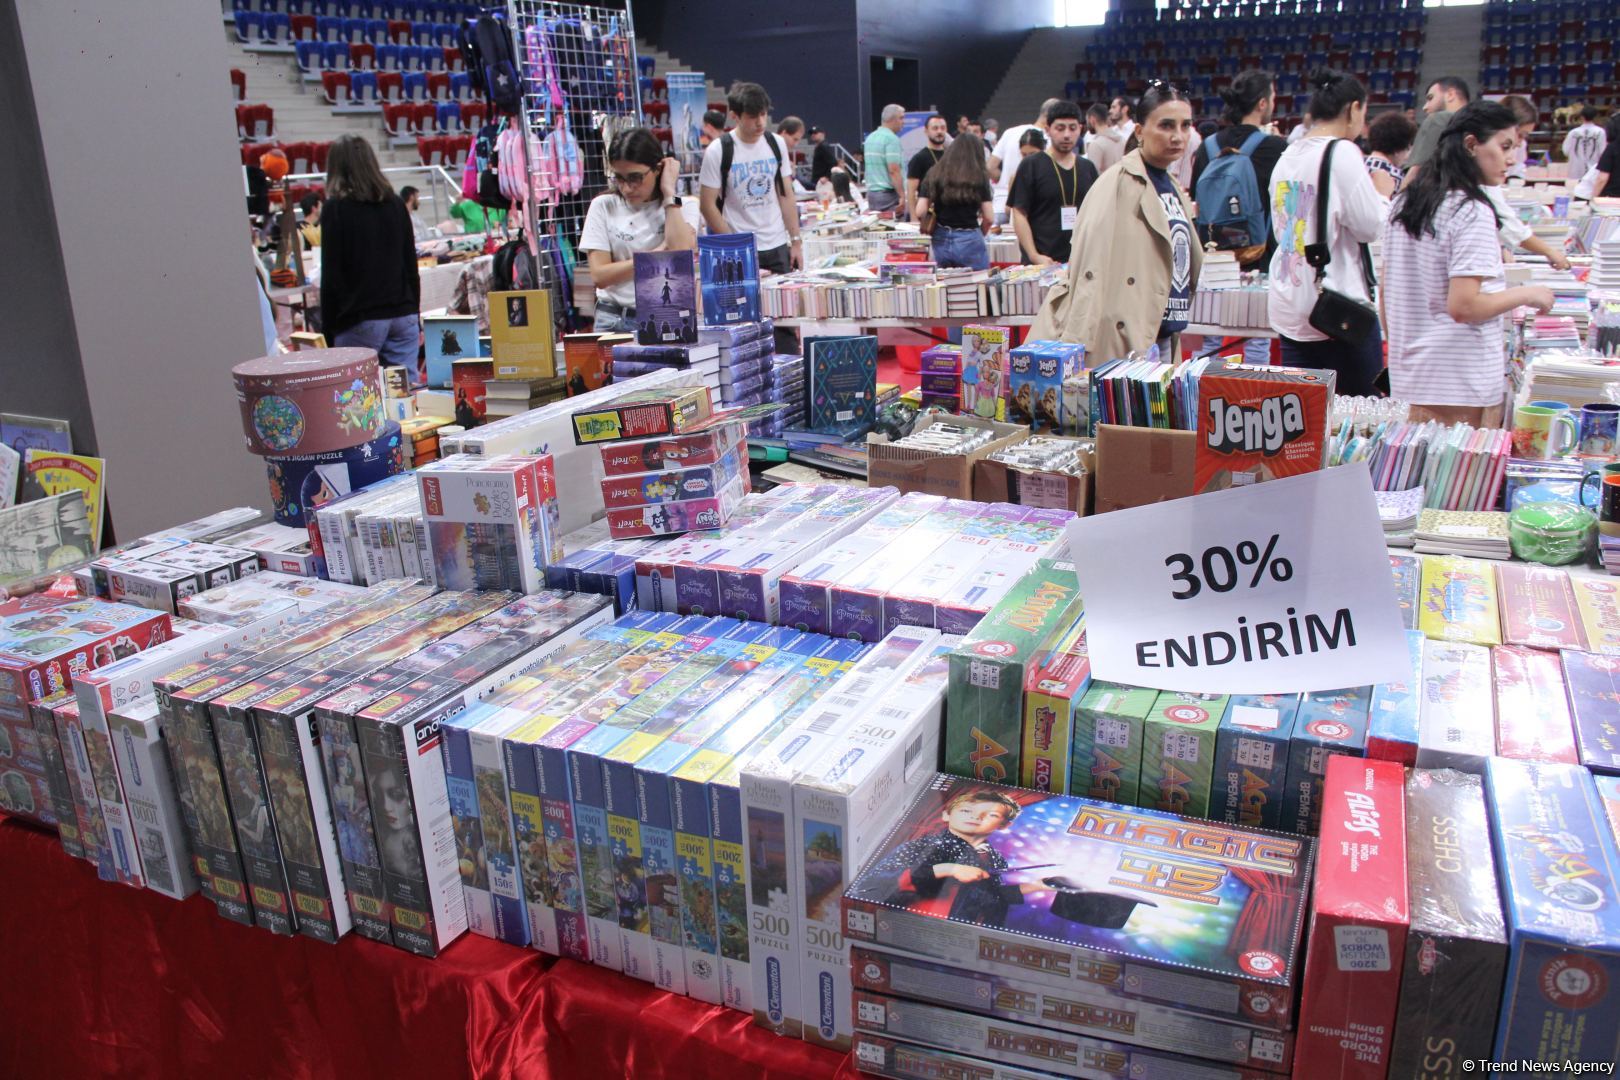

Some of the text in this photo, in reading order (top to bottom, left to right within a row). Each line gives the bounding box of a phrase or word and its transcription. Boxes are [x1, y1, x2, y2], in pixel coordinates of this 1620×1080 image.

[1013, 355, 1031, 368] Jenga
[1039, 359, 1057, 371] Jenga
[1208, 392, 1304, 451] Jenga
[1284, 441, 1315, 449] Classique
[291, 454, 316, 462] JIGSAW
[316, 451, 343, 461] PUZZLE
[612, 456, 629, 466] Trefl
[427, 480, 439, 502] Trefl
[611, 488, 629, 499] Trefl
[492, 490, 502, 518] Puzzle
[502, 491, 513, 518] 500
[617, 519, 634, 530] Trefl
[655, 515, 665, 524] 30
[1164, 533, 1294, 600] 30%
[724, 587, 758, 602] PRINCESS
[793, 596, 811, 605] Disney
[784, 600, 819, 616] PRINCESS
[847, 605, 865, 614] Disney
[836, 609, 873, 625] PRINCESS
[900, 613, 919, 622] Disney
[1135, 606, 1357, 668] ENDİRİM
[853, 723, 897, 740] 500
[506, 743, 517, 789] Ravensburger
[536, 747, 547, 794] Ravensburger
[571, 753, 583, 801] Ravensburger
[603, 763, 614, 811] Ravensburger
[1228, 772, 1238, 805] ВРЕМЯ
[636, 773, 648, 822] Ravensburger
[676, 781, 685, 829] Ravensburger
[1299, 782, 1311, 817] ВРЕМЯ
[103, 804, 122, 818] 2x60
[132, 804, 159, 826] 1000
[518, 802, 535, 814] 300
[549, 807, 565, 819] 100
[711, 786, 721, 837] Ravensburger
[615, 825, 633, 837] 300
[648, 836, 667, 848] 300
[1067, 805, 1302, 876] MAGIC
[1432, 816, 1460, 874] CHESS
[721, 851, 741, 863] 200
[1350, 842, 1358, 873] explanation
[1360, 841, 1368, 861] WORD
[494, 877, 508, 888] 150
[719, 869, 730, 883] 8+
[1109, 850, 1228, 905] 45
[753, 911, 790, 937] 500
[568, 915, 583, 954] PRINCESS
[754, 935, 790, 951] PUZZLE
[806, 926, 845, 951] 500
[979, 935, 1072, 977] MAGIC
[1340, 943, 1384, 952] WORDS
[1340, 951, 1386, 960] ENGLISH
[807, 950, 844, 967] PUZZLE
[1245, 951, 1279, 964] Piatnik
[1350, 960, 1378, 968] 3200
[769, 960, 780, 1010] Clementoni
[823, 974, 834, 1026] Clementoni
[1310, 1024, 1384, 1044] explanation
[1350, 1022, 1385, 1034] game
[986, 1026, 1079, 1066] MAGIC
[1339, 1040, 1382, 1055] WORD
[1355, 1052, 1381, 1064] THE
